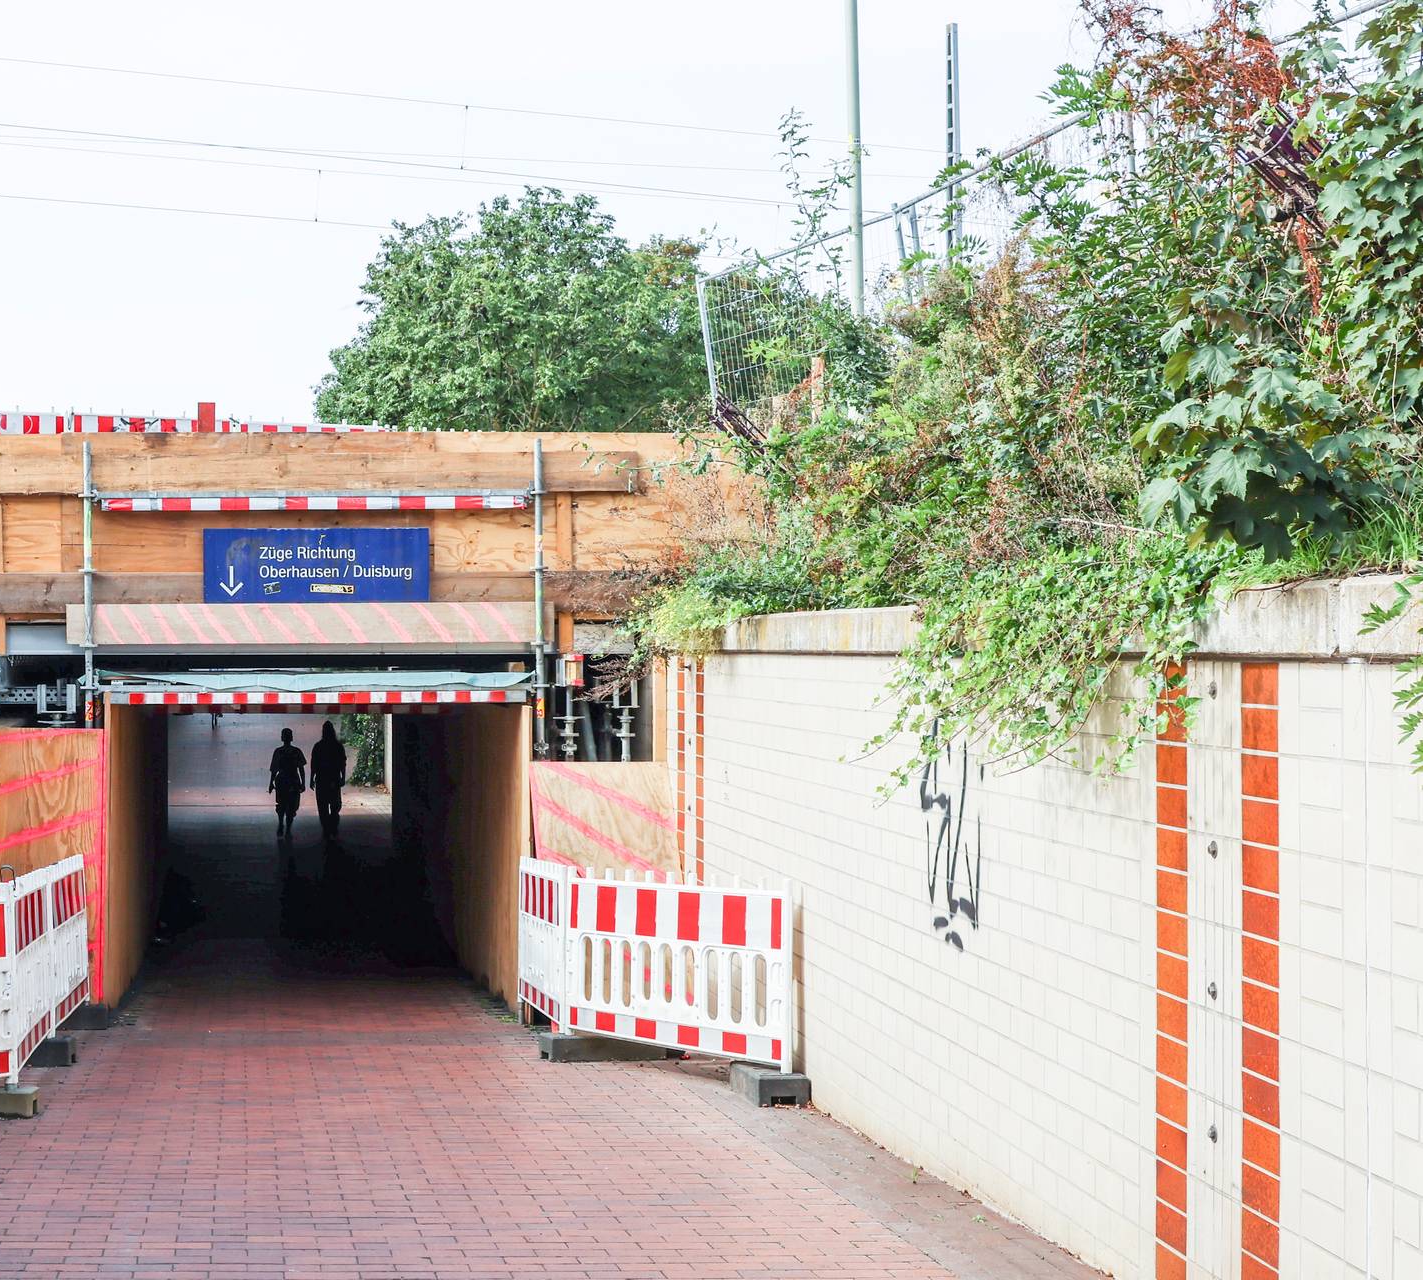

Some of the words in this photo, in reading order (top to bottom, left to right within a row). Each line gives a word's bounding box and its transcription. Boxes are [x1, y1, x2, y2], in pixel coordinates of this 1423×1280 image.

[259, 546, 293, 561] Züge
[297, 546, 356, 561] Richtung
[259, 565, 340, 578] Oberhausen
[343, 565, 350, 578] /
[353, 565, 413, 580] Duisburg
